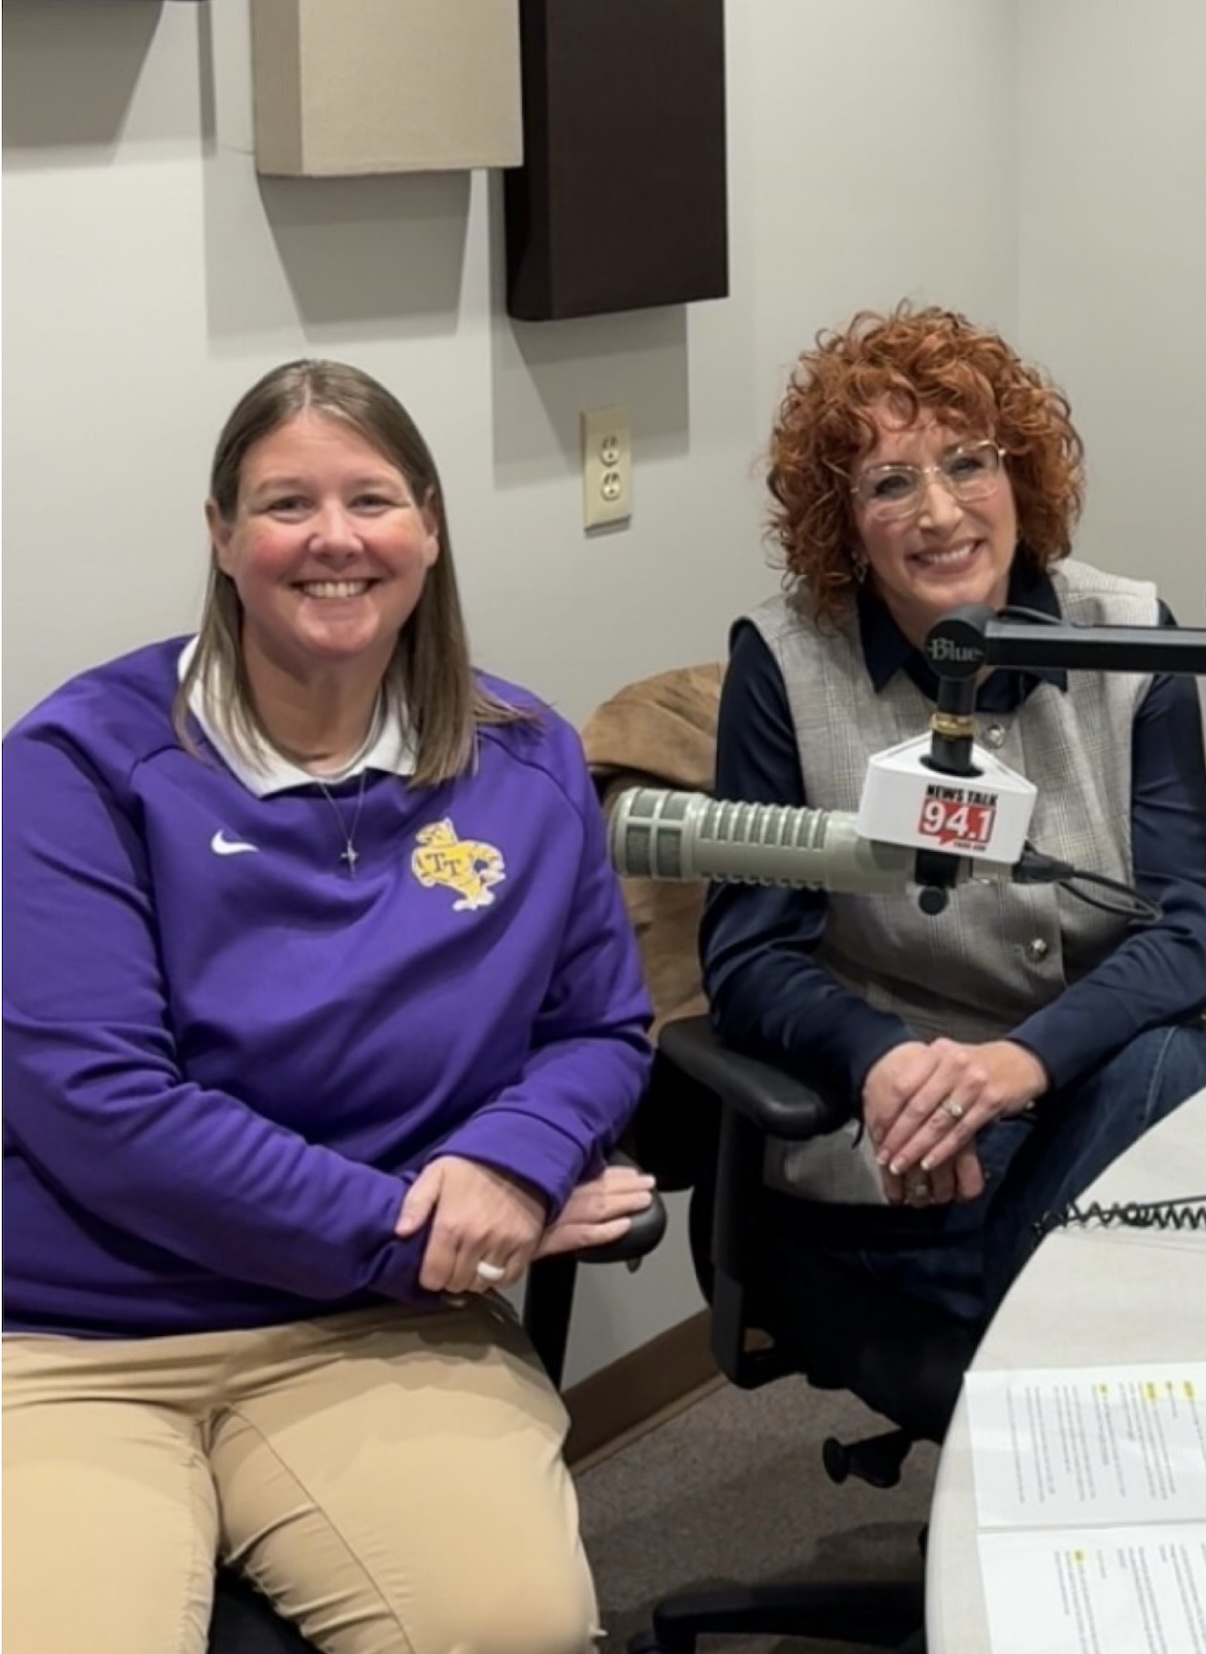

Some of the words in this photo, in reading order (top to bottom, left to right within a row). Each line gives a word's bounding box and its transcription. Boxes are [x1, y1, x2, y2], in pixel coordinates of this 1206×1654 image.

[929, 637, 984, 662] Blue
[927, 784, 964, 802] NEWS
[967, 791, 998, 807] TALK
[923, 800, 992, 841] 94.1
